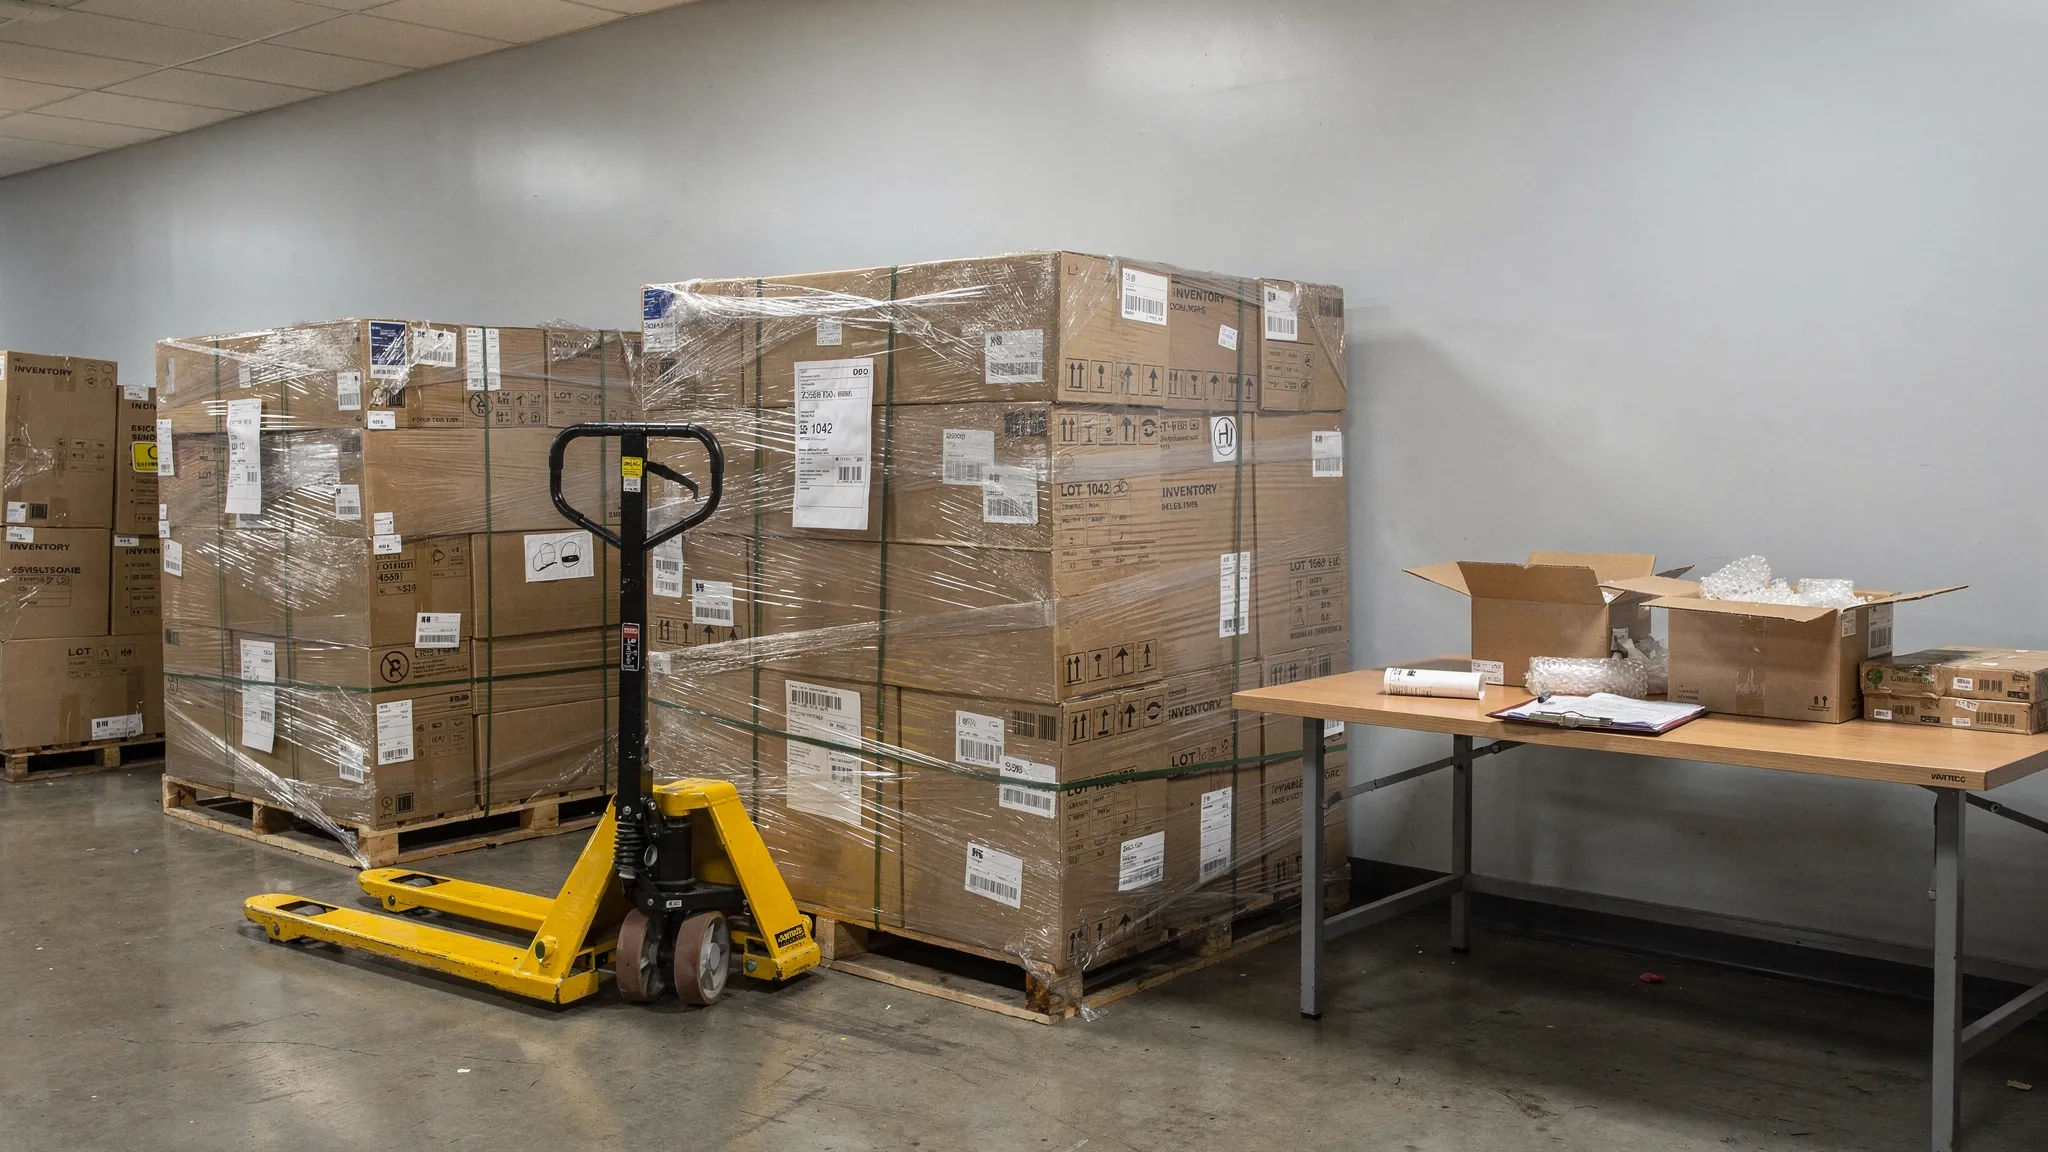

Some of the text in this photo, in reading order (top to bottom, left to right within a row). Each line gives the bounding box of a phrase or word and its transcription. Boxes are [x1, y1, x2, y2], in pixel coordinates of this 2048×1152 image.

[1171, 287, 1226, 304] INVENTORY
[14, 365, 73, 377] INVENTORY
[811, 423, 833, 434] 1042
[1061, 482, 1111, 497] LOT 1042
[1162, 483, 1218, 498] INVENTORY
[10, 543, 71, 551] INVENTORY
[1290, 560, 1307, 572] LOT
[68, 647, 92, 657] LOT
[1168, 698, 1222, 721] INVENTORY
[1171, 751, 1197, 768] LOT
